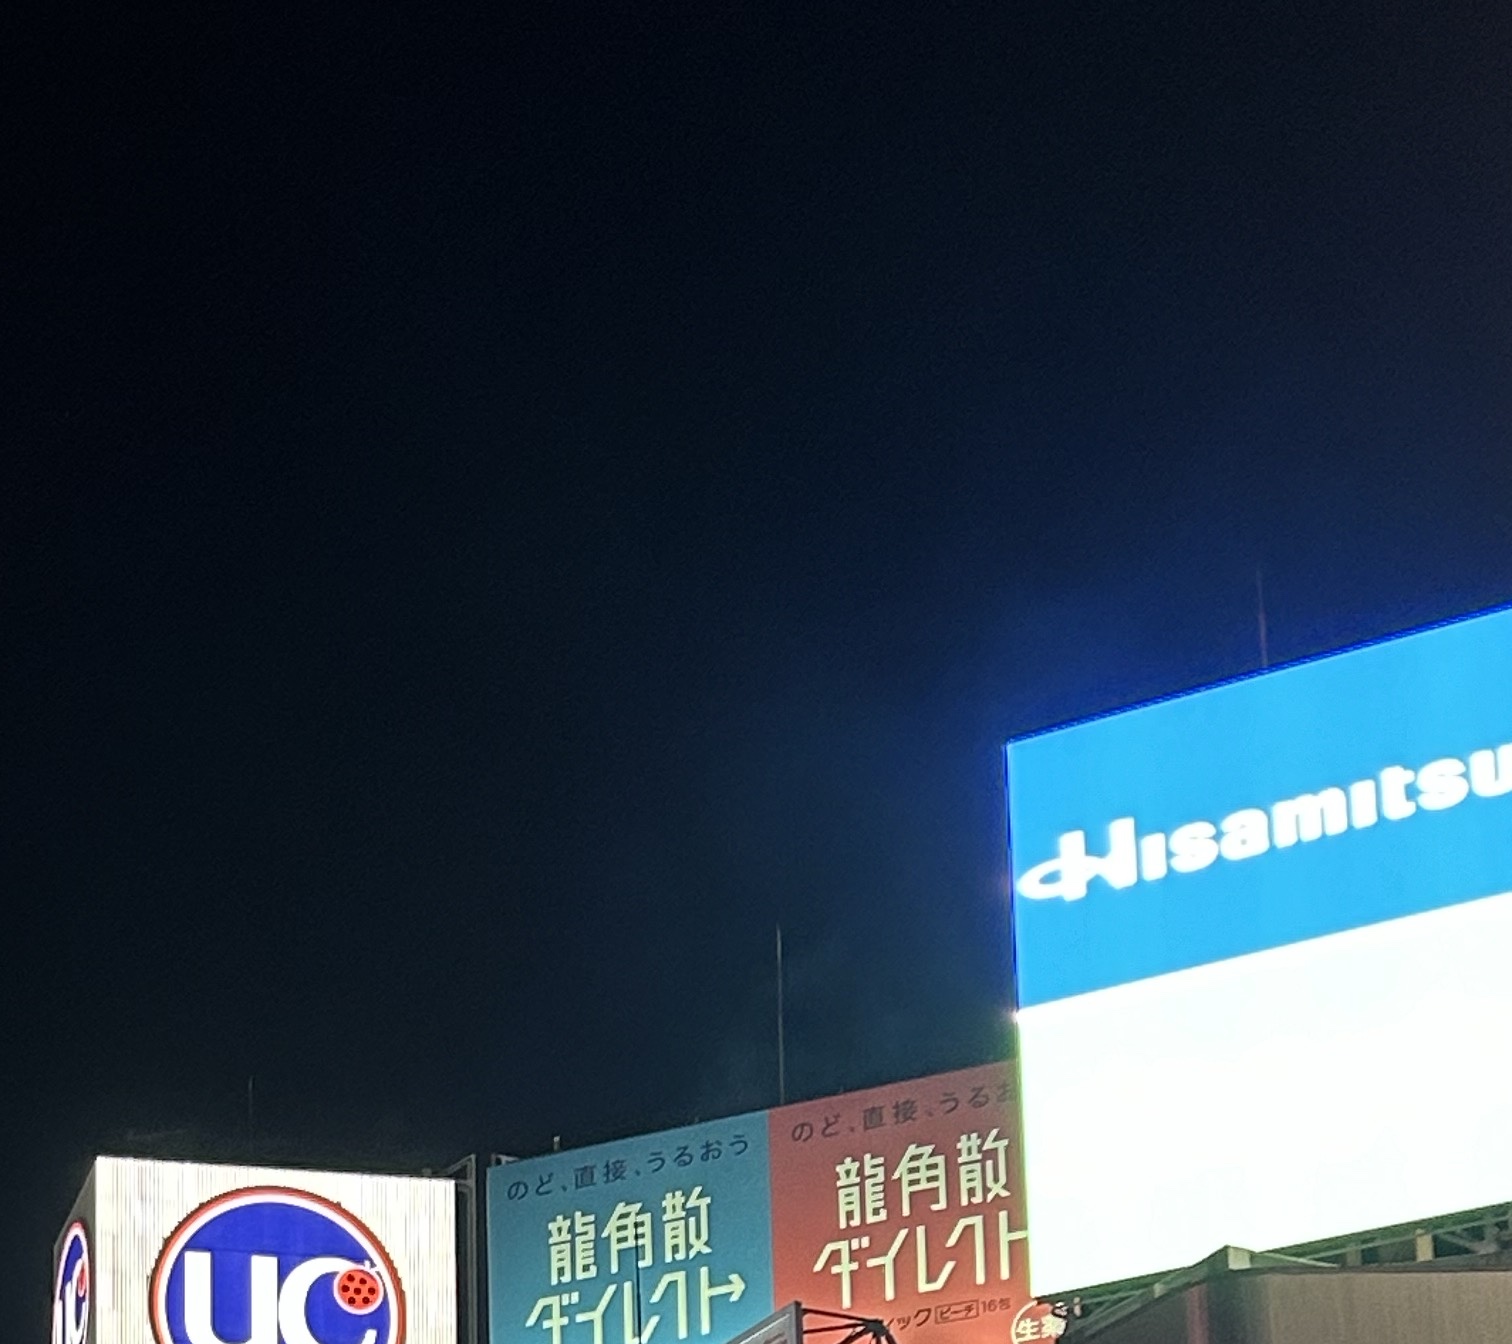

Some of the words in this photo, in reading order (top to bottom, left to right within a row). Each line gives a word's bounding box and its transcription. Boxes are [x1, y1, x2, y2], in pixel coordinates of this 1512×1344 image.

[506, 1132, 750, 1202] のど、直接、うるおう
[835, 1127, 1011, 1230] 龍角散
[547, 1186, 712, 1286] 龍角散
